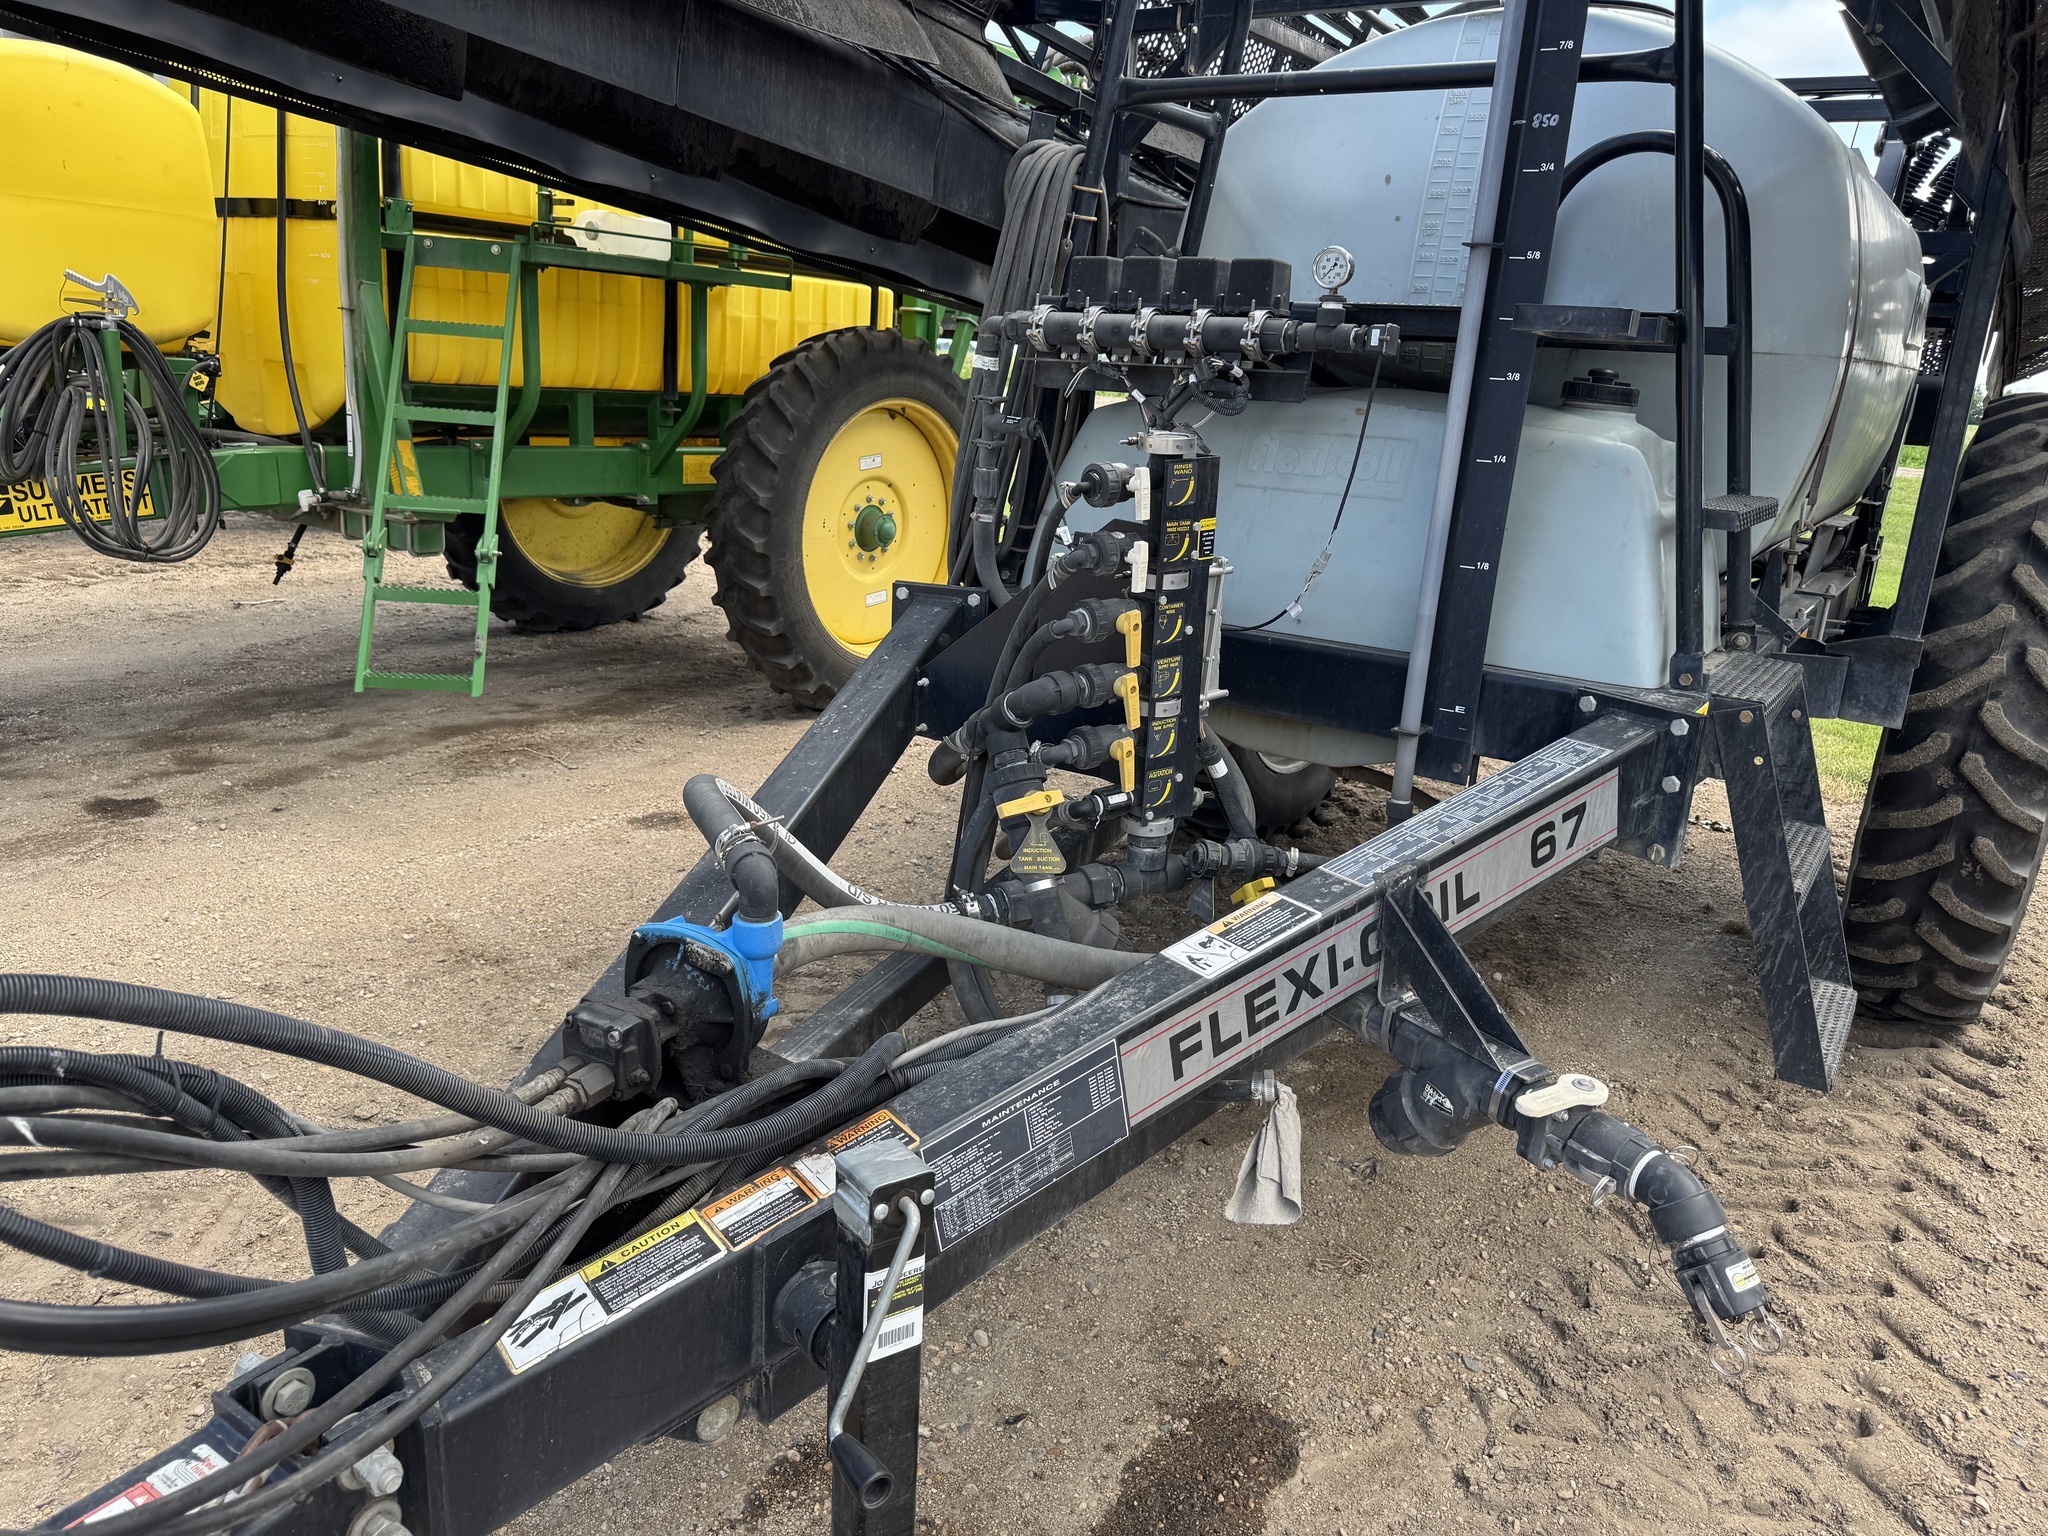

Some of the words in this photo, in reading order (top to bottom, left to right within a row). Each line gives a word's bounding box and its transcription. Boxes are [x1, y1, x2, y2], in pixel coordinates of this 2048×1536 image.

[1559, 40, 1574, 49] 7/8
[1532, 113, 1560, 128] 850
[1540, 163, 1555, 172] 3/4
[1526, 251, 1541, 260] 5/8
[1506, 372, 1521, 381] 3/8
[1493, 455, 1507, 464] 1/4
[12, 471, 138, 502] SUMES
[1476, 561, 1490, 571] 1/8
[1158, 602, 1184, 611] CONTAINER
[1157, 656, 1181, 664] VENTURI
[1455, 705, 1466, 714] E
[1152, 717, 1177, 727] INDUCTION
[1148, 768, 1173, 779] AGITATION
[1530, 800, 1586, 869] 67
[1231, 899, 1268, 921] WARNING
[981, 1079, 1061, 1129] MAINTENANCE
[836, 1113, 887, 1145] WARNING
[727, 1204, 772, 1231] ELECTROCUTION
[770, 1191, 793, 1206] HAZARD
[620, 1221, 680, 1257] CAUTION
